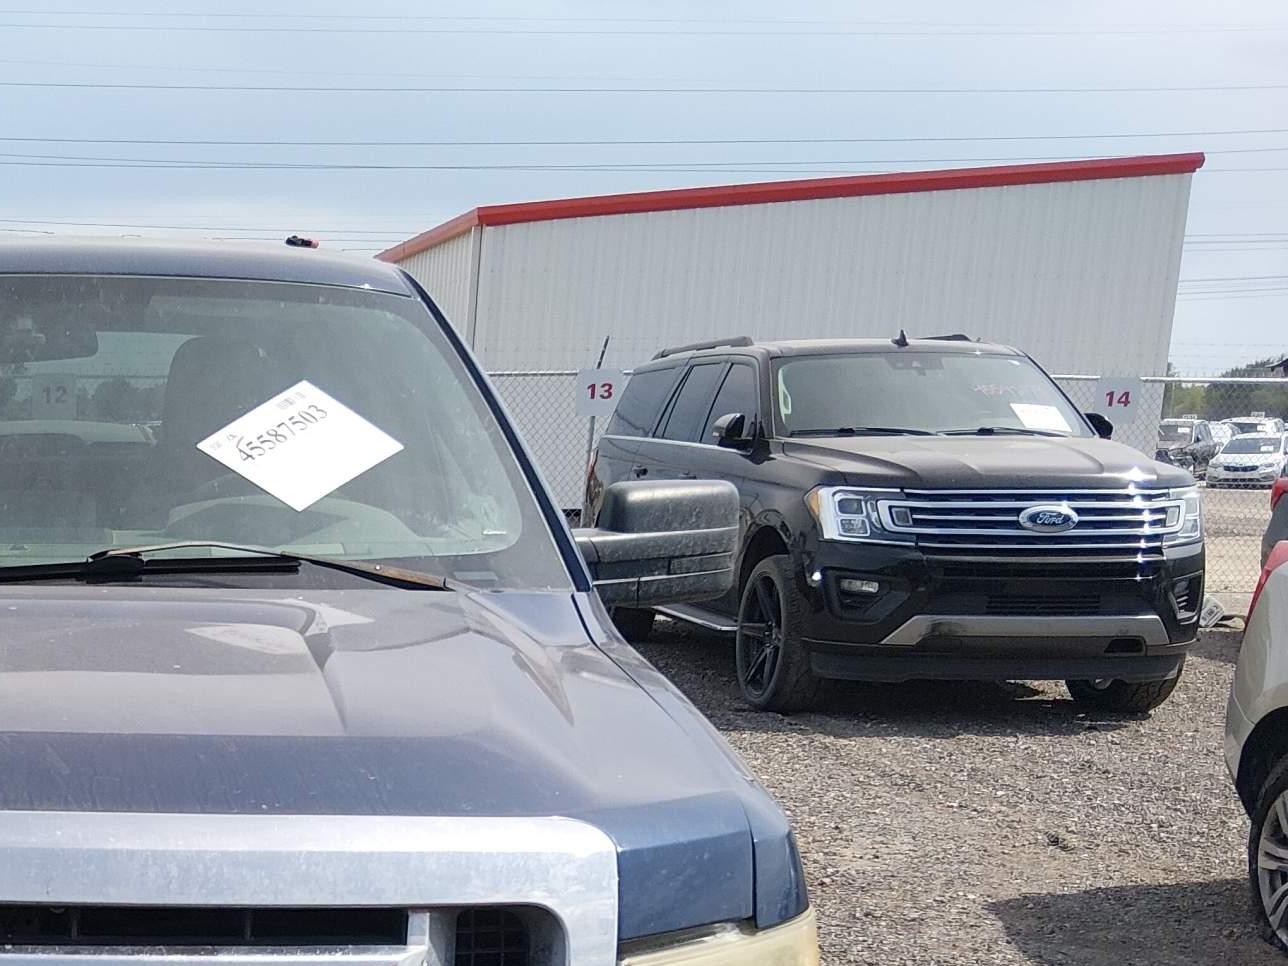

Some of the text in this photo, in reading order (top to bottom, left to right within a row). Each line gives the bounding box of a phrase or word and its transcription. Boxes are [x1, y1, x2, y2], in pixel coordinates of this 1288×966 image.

[42, 385, 67, 403] 12
[587, 383, 613, 399] 13
[1106, 391, 1131, 407] 14
[237, 404, 327, 461] 45587503
[1036, 511, 1065, 524] Ford
